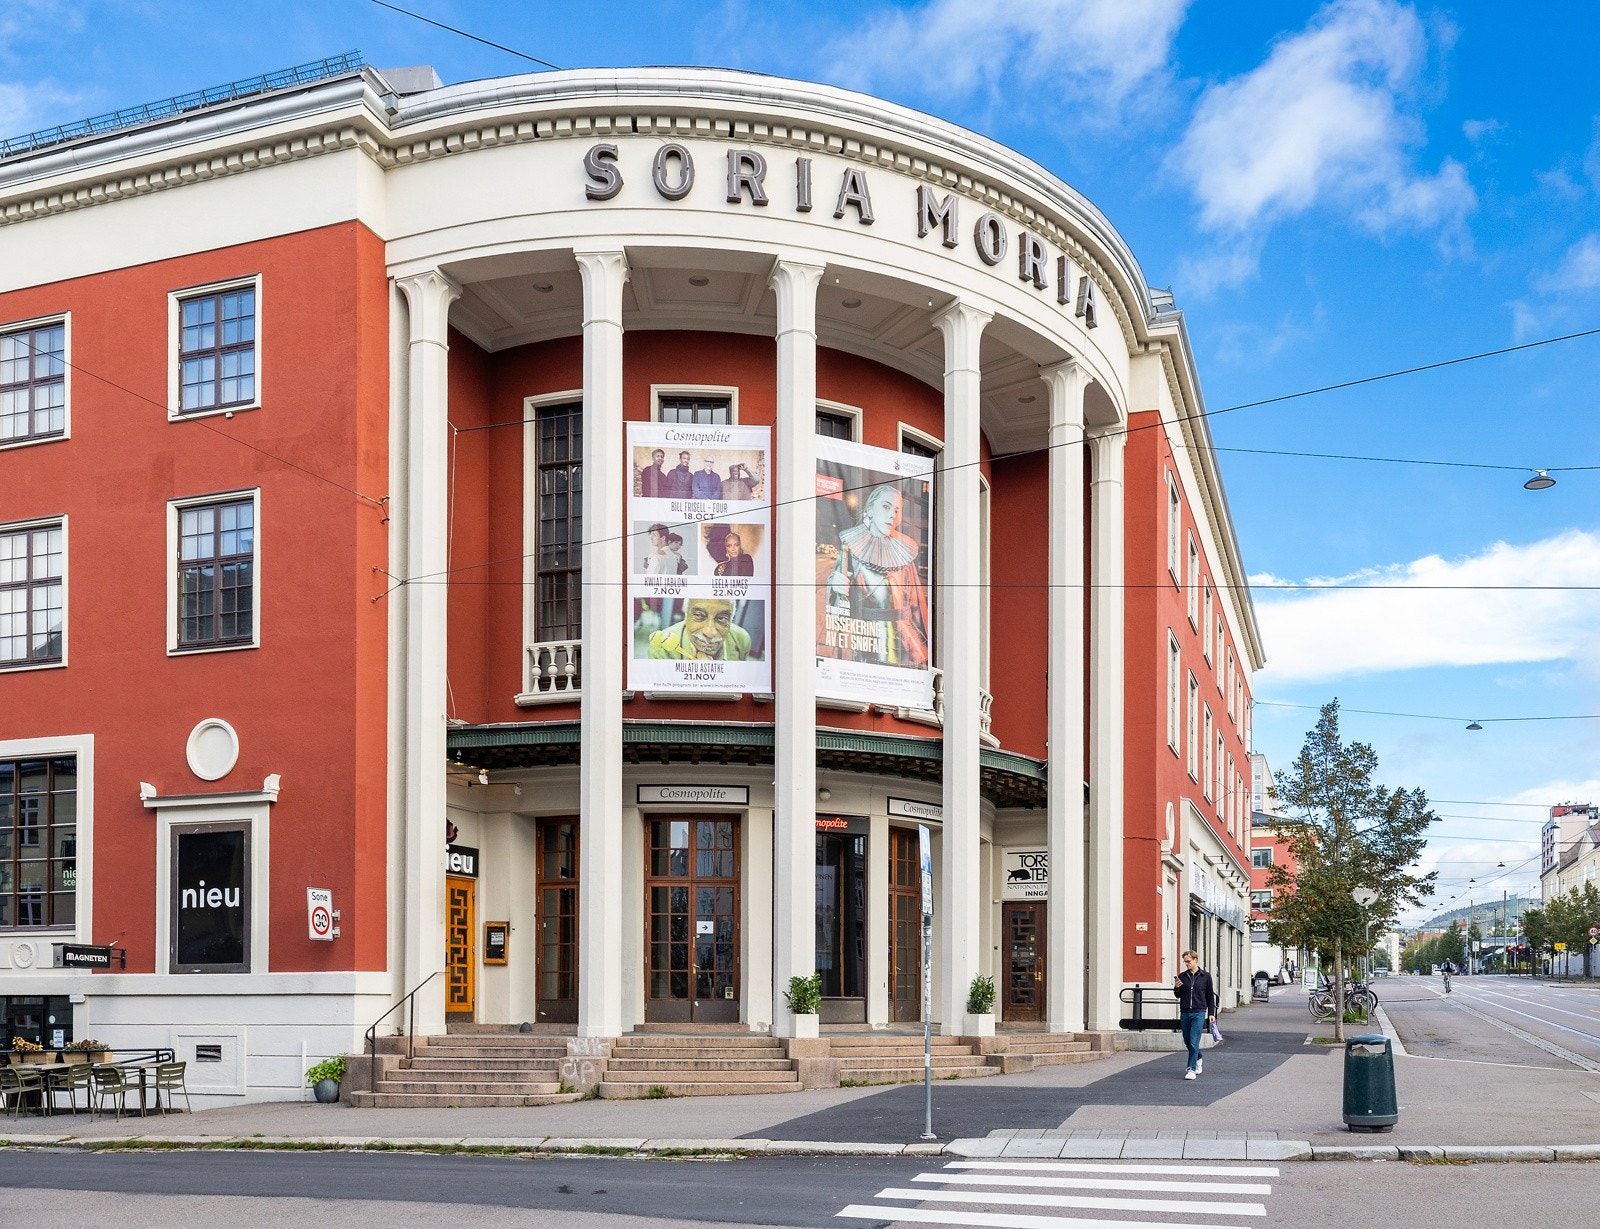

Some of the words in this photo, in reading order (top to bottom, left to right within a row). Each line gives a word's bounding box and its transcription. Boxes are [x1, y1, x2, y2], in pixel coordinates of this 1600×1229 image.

[583, 143, 876, 225] SORIA
[917, 185, 1098, 329] MORIA
[665, 429, 730, 445] Cosmopolite
[671, 502, 683, 512] BILL
[684, 502, 706, 513] FRISELL
[712, 503, 728, 513] FOUR
[644, 577, 662, 587] KWIAT
[712, 579, 728, 589] LEELA
[729, 579, 748, 589] JAMES
[653, 587, 681, 595] 7.NOV
[713, 588, 747, 597] 22.NOV
[826, 614, 881, 637] DISSEKERING
[826, 631, 837, 647] AV
[839, 633, 849, 649] ET
[675, 663, 698, 673] MULATU
[700, 663, 724, 673] ASTATKE
[660, 788, 726, 801] Cosmopolite
[903, 802, 943, 818] Cosmopolite
[815, 817, 848, 831] mopolite
[446, 843, 474, 874] ieu
[1019, 854, 1048, 868] TORS
[63, 867, 76, 878] nie
[1029, 867, 1048, 880] TEA
[182, 880, 240, 908] nieu
[311, 891, 328, 901] Sone
[315, 913, 327, 928] 30
[66, 952, 108, 962] MAGNETEN
